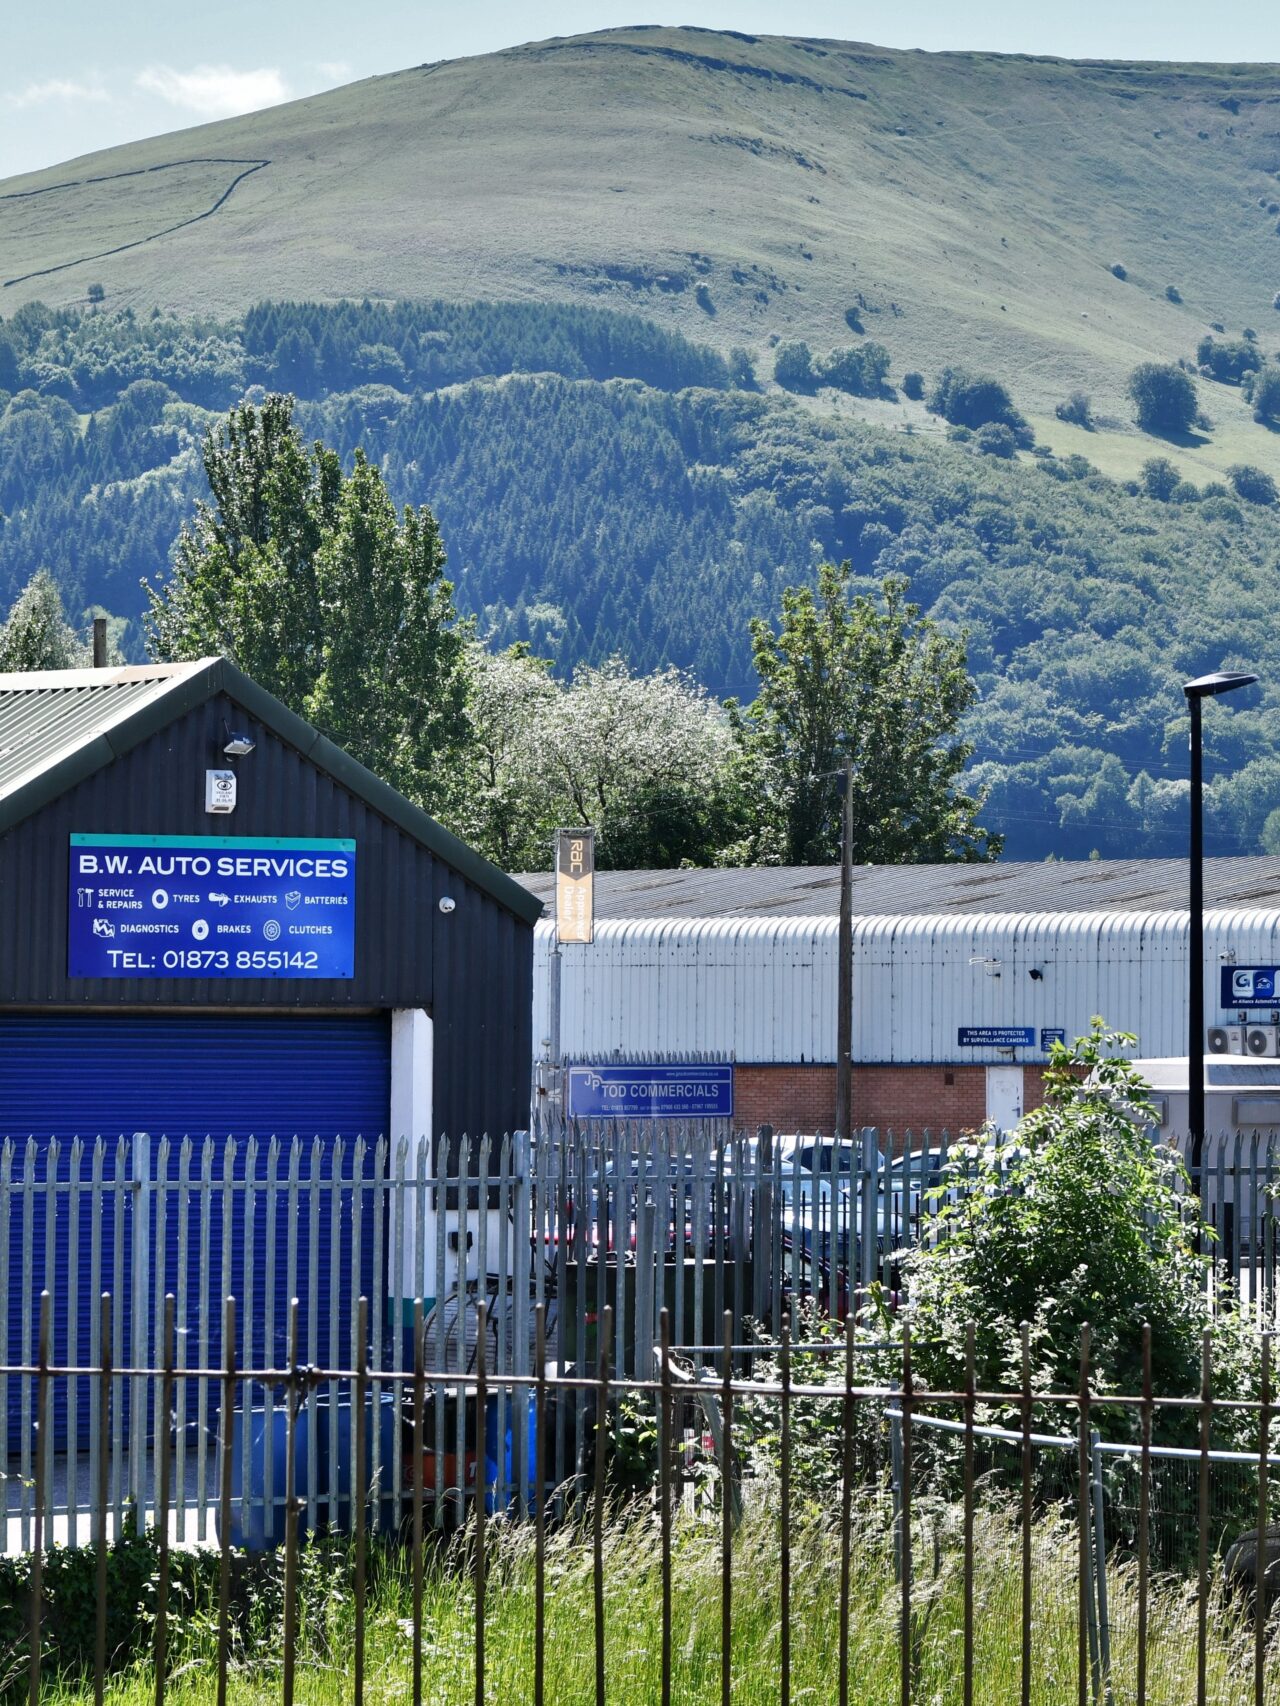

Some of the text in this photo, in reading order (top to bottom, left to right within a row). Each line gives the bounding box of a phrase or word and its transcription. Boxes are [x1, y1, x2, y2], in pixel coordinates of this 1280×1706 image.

[79, 855, 349, 878] B.W. AUTO SERVICES
[98, 889, 135, 898] SERVICE
[173, 894, 200, 903] TYRES
[234, 895, 278, 904] EXHAUSTS
[304, 896, 348, 905] BATTERIES
[98, 900, 143, 909] & REPAIRS
[120, 924, 179, 934] DIAGNOSTICS
[217, 925, 252, 934] BRAKES
[289, 925, 333, 935] CLUTCHES
[107, 950, 319, 970] TEL: 01873 855142
[602, 1085, 627, 1098] TOD
[630, 1084, 719, 1098] COMMERCIALS
